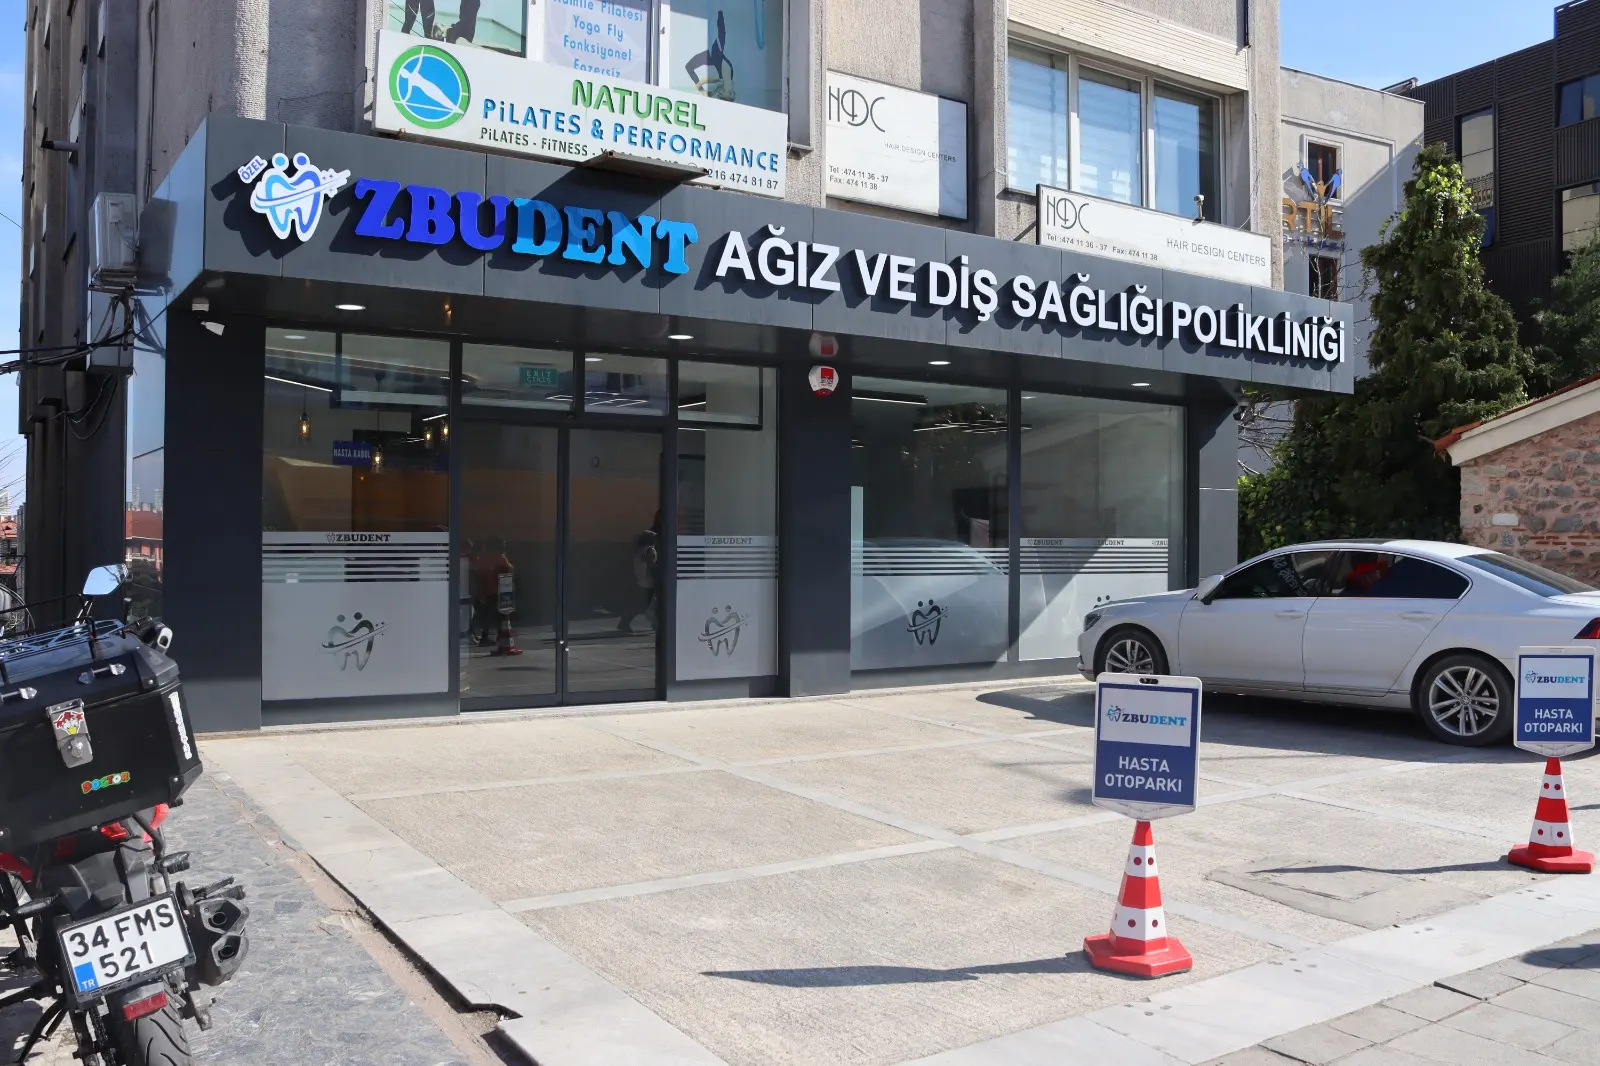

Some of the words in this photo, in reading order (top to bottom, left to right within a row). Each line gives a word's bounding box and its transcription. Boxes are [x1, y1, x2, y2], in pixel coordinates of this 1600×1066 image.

[601, 1, 643, 21] Pilatesi
[573, 14, 600, 35] Yoga
[607, 23, 623, 42] Fly
[563, 34, 632, 61] Fonksiyonel
[571, 79, 706, 131] NATUREL
[590, 118, 604, 140] &
[613, 122, 779, 173] PERFORMANCE
[885, 142, 900, 152] HAIR
[902, 145, 926, 157] DESIGN
[928, 151, 957, 163] CENTERS
[239, 159, 265, 181] ÖZEL
[858, 171, 865, 179] 11
[881, 175, 889, 183] 37
[729, 173, 748, 185] 474
[751, 176, 762, 187] 81
[766, 179, 779, 190] 87
[846, 178, 859, 187] 474
[860, 180, 868, 188] 11
[870, 182, 878, 190] 38
[354, 176, 699, 275] ZBUDENT
[1076, 239, 1083, 247] 11
[1085, 241, 1094, 249] 36
[1100, 243, 1108, 251] 37
[1128, 249, 1140, 258] 474
[1150, 253, 1158, 261] 38
[1167, 238, 1189, 251] HAIR
[1191, 242, 1225, 258] DESIGN
[1227, 250, 1266, 267] CENTERS
[715, 223, 841, 292] AĞIZ
[855, 248, 917, 302] VE
[929, 254, 998, 322] DİŞ
[1011, 272, 1163, 337] SAĞLIĞI
[1172, 301, 1345, 363] POLİKLİNİĞİ
[526, 370, 552, 378] EXIT
[333, 448, 352, 458] HASTA
[353, 449, 371, 459] KABUL
[335, 533, 391, 542] ZBUDENT
[711, 537, 753, 545] ZBUDENT
[1536, 675, 1586, 684] ZBUDENT
[1122, 712, 1187, 727] ZBUDENT
[1534, 708, 1574, 719] HASTA
[1524, 722, 1583, 734] OTOPARKI
[1118, 755, 1170, 773] HASTA
[1104, 773, 1182, 793] OTOPARKI
[69, 925, 110, 957] 34
[114, 903, 175, 942] FMS
[99, 941, 153, 978] 521
[81, 979, 96, 990] TR
